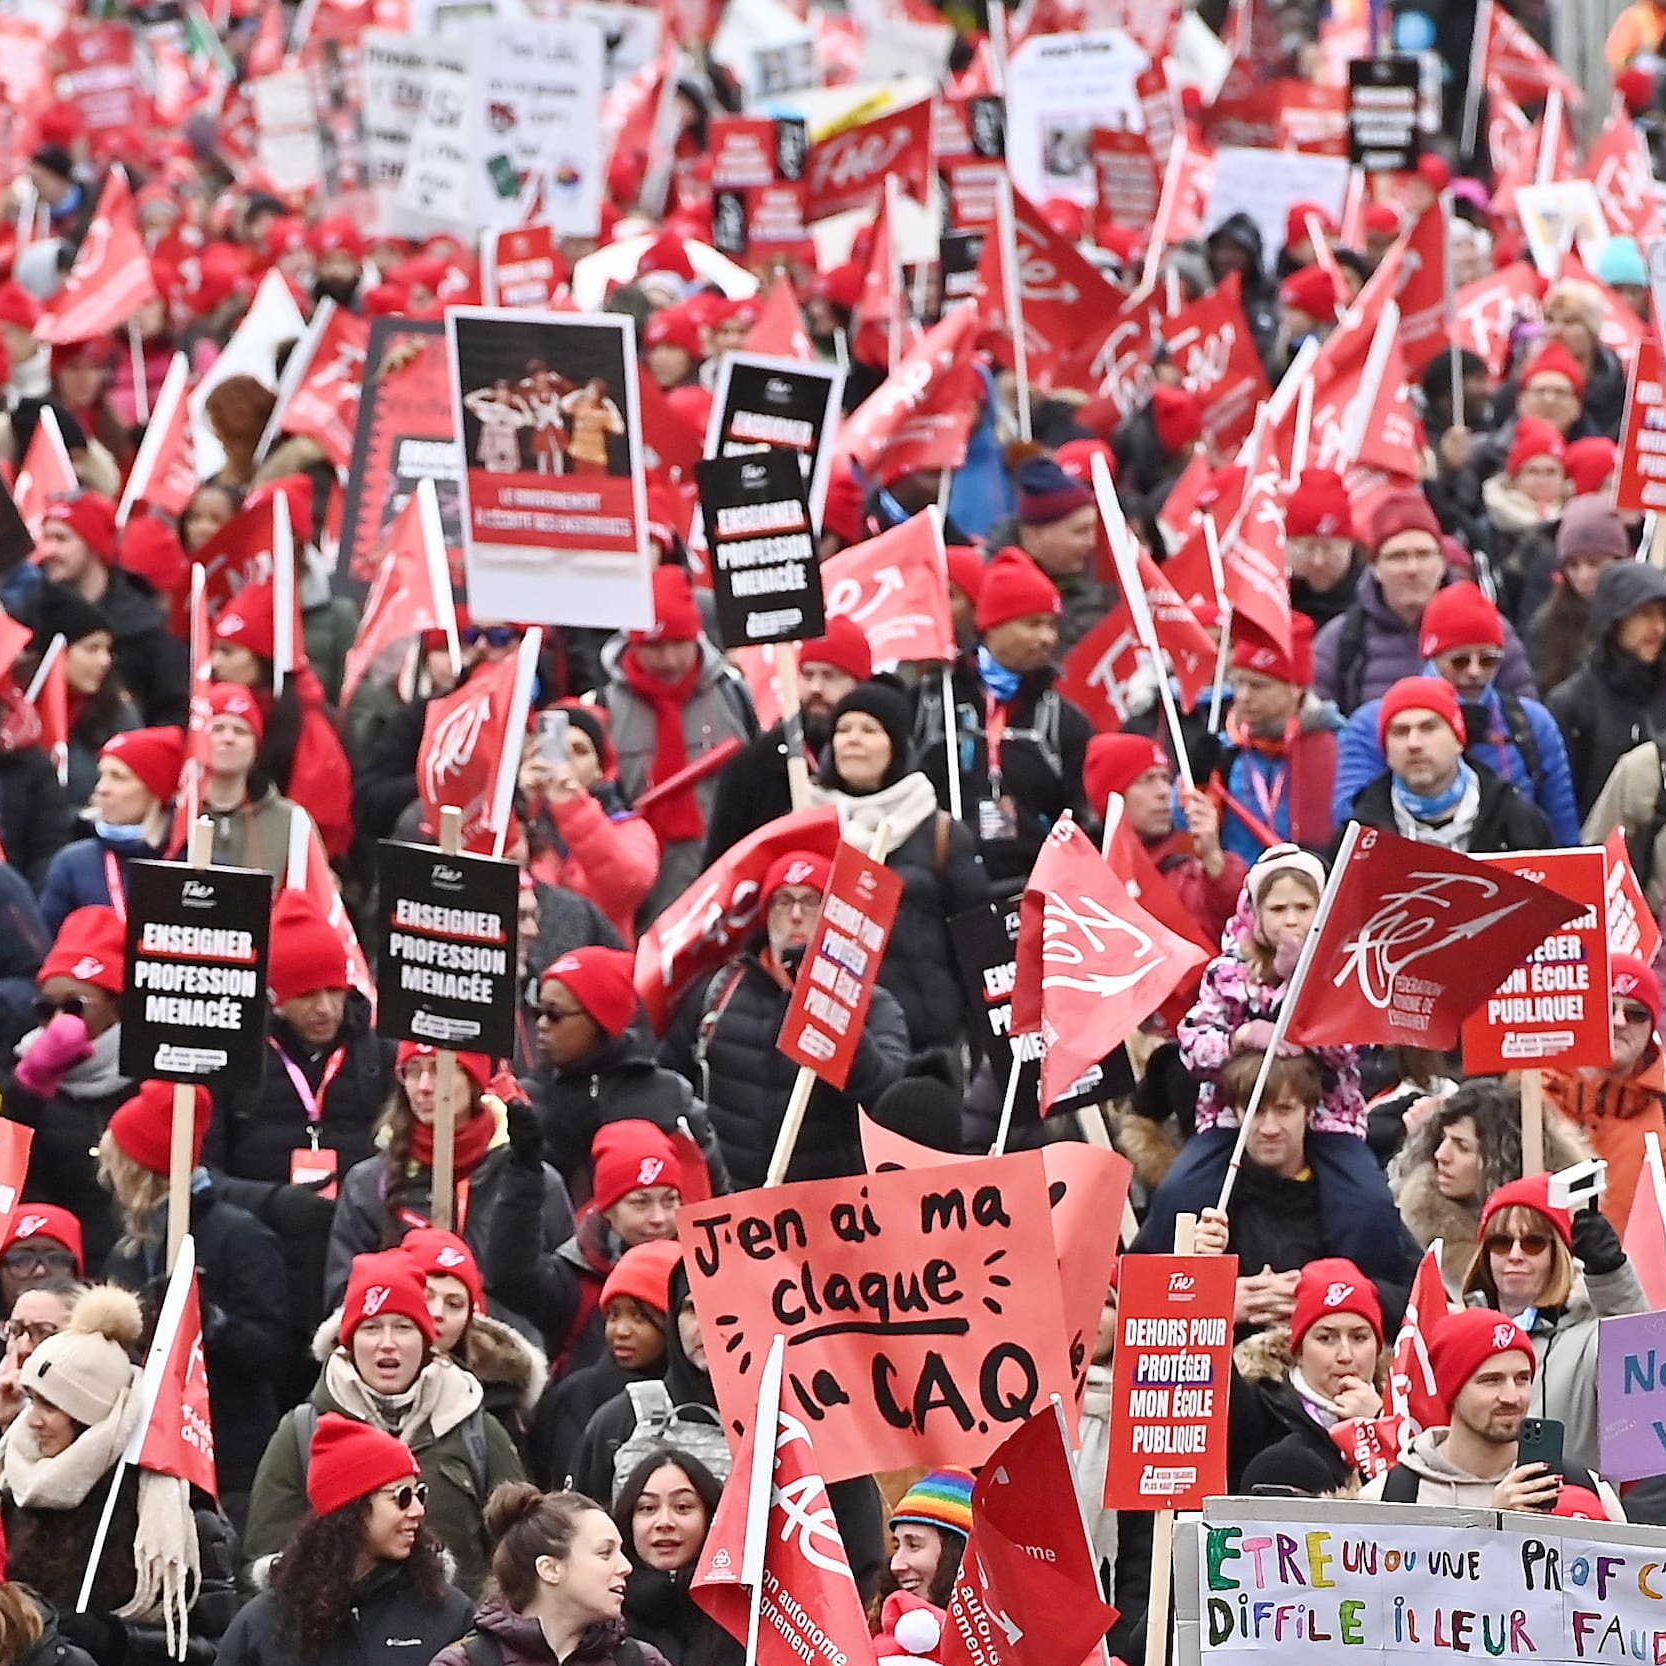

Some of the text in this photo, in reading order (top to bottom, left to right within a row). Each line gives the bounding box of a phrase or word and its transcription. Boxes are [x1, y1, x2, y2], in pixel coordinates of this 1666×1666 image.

[396, 899, 500, 938] ENSEIGNER
[143, 922, 252, 958] ENSEIGNER
[390, 932, 506, 974] PROFESSION
[135, 960, 256, 997] PROFESSION
[401, 965, 492, 1003] MENACÉE
[1531, 963, 1589, 990] ÉCOLE
[145, 995, 243, 1029] MENACÉE
[1489, 995, 1584, 1024] PUBLIQUE!
[831, 1187, 880, 1241] ai
[921, 1185, 1011, 1233] ma
[772, 1259, 963, 1325] claque
[1125, 1318, 1226, 1346] DEHORS POUR
[1136, 1349, 1211, 1382] PROTÉGER
[790, 1369, 850, 1420] la
[1129, 1385, 1212, 1418] MON ÉCOLE
[1132, 1424, 1206, 1454] PUBLIQUE!
[1521, 1539, 1625, 1600] PROF
